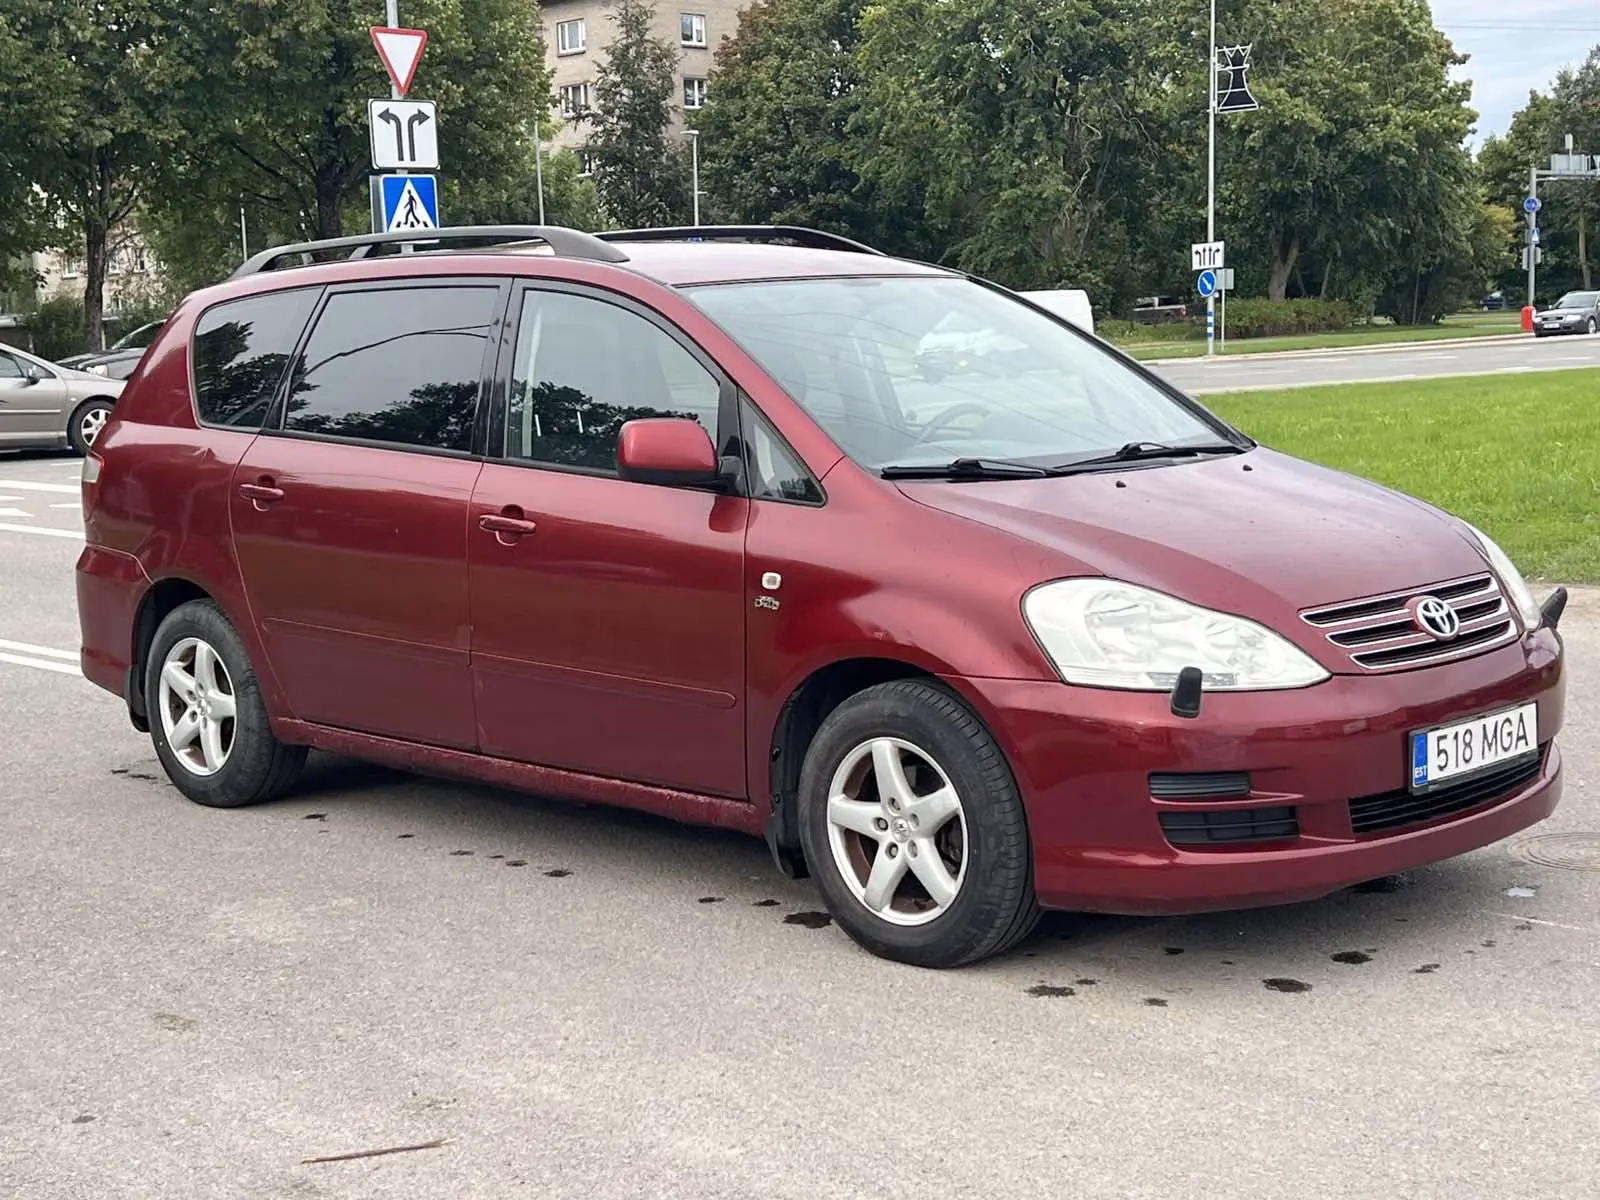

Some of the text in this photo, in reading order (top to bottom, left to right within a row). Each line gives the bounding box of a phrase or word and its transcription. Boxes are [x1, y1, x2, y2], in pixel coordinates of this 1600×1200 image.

[1436, 712, 1529, 772] 518 MGA
[1414, 765, 1427, 778] EST
